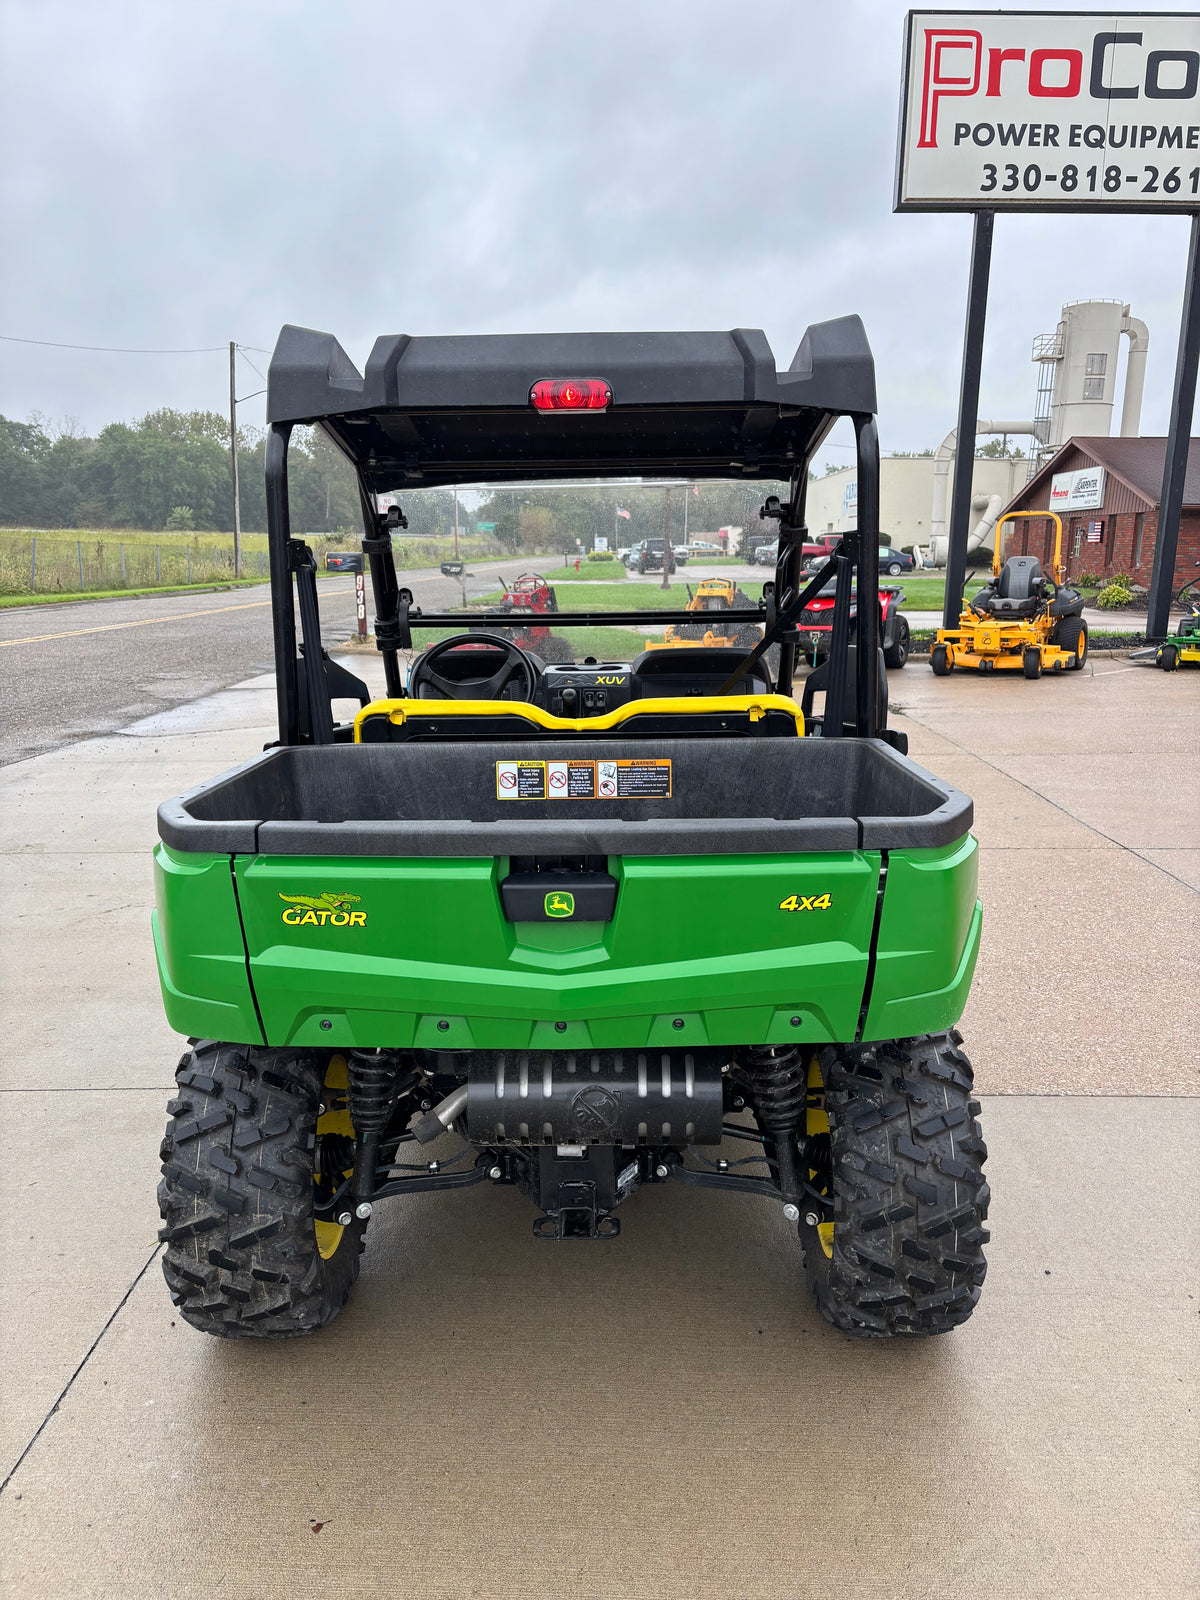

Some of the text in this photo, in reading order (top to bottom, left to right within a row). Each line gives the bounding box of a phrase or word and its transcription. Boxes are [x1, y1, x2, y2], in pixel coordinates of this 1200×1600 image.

[954, 122, 1200, 150] POWER EQUIPME
[979, 163, 1200, 194] 330-818-261
[356, 575, 365, 619] 938
[595, 676, 626, 685] XUV
[281, 909, 367, 927] GATOR
